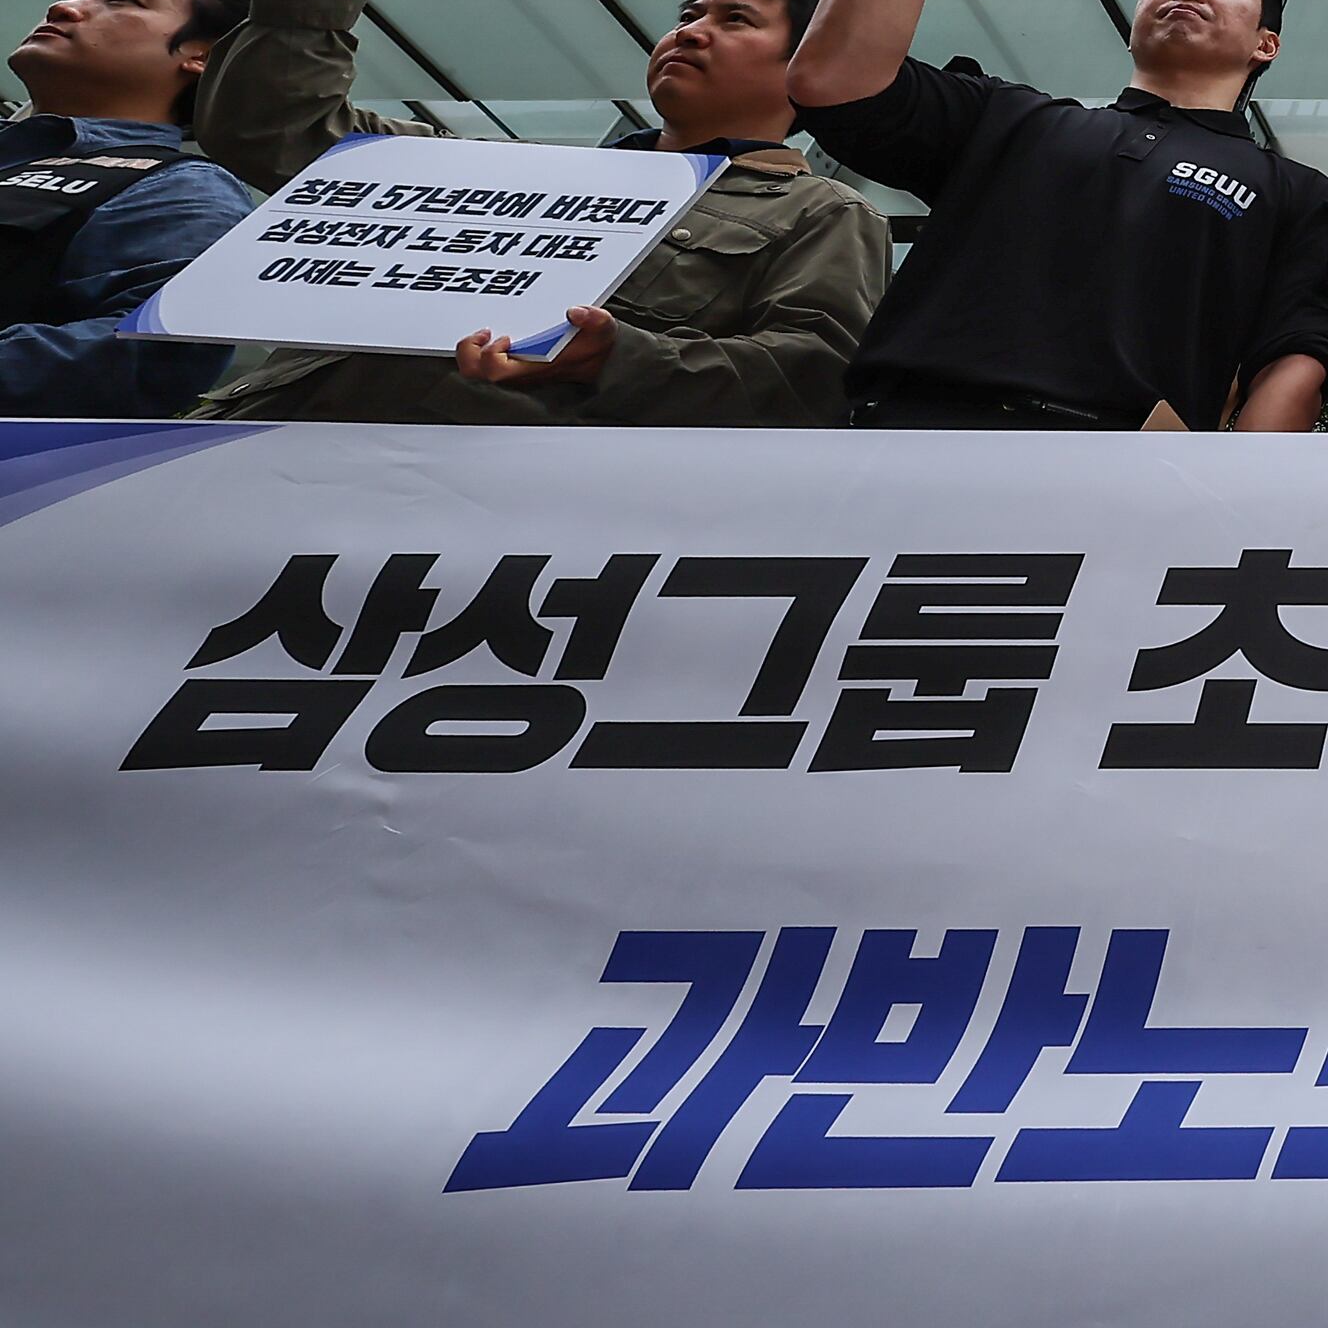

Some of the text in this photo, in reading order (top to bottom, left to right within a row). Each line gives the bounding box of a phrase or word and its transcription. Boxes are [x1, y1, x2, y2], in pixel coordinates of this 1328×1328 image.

[0, 170, 99, 194] SELU
[285, 179, 668, 225] 창립 57년만에 바꿨다
[1166, 175, 1244, 217] SAMSUNG GROUP
[1168, 185, 1234, 221] UNITED UNION
[1172, 162, 1257, 210] SGUU
[258, 219, 602, 261] 삼성전자 노동자 대표,
[259, 258, 541, 295] 이제는 노동조합!
[118, 554, 1085, 773] 삼성그룹
